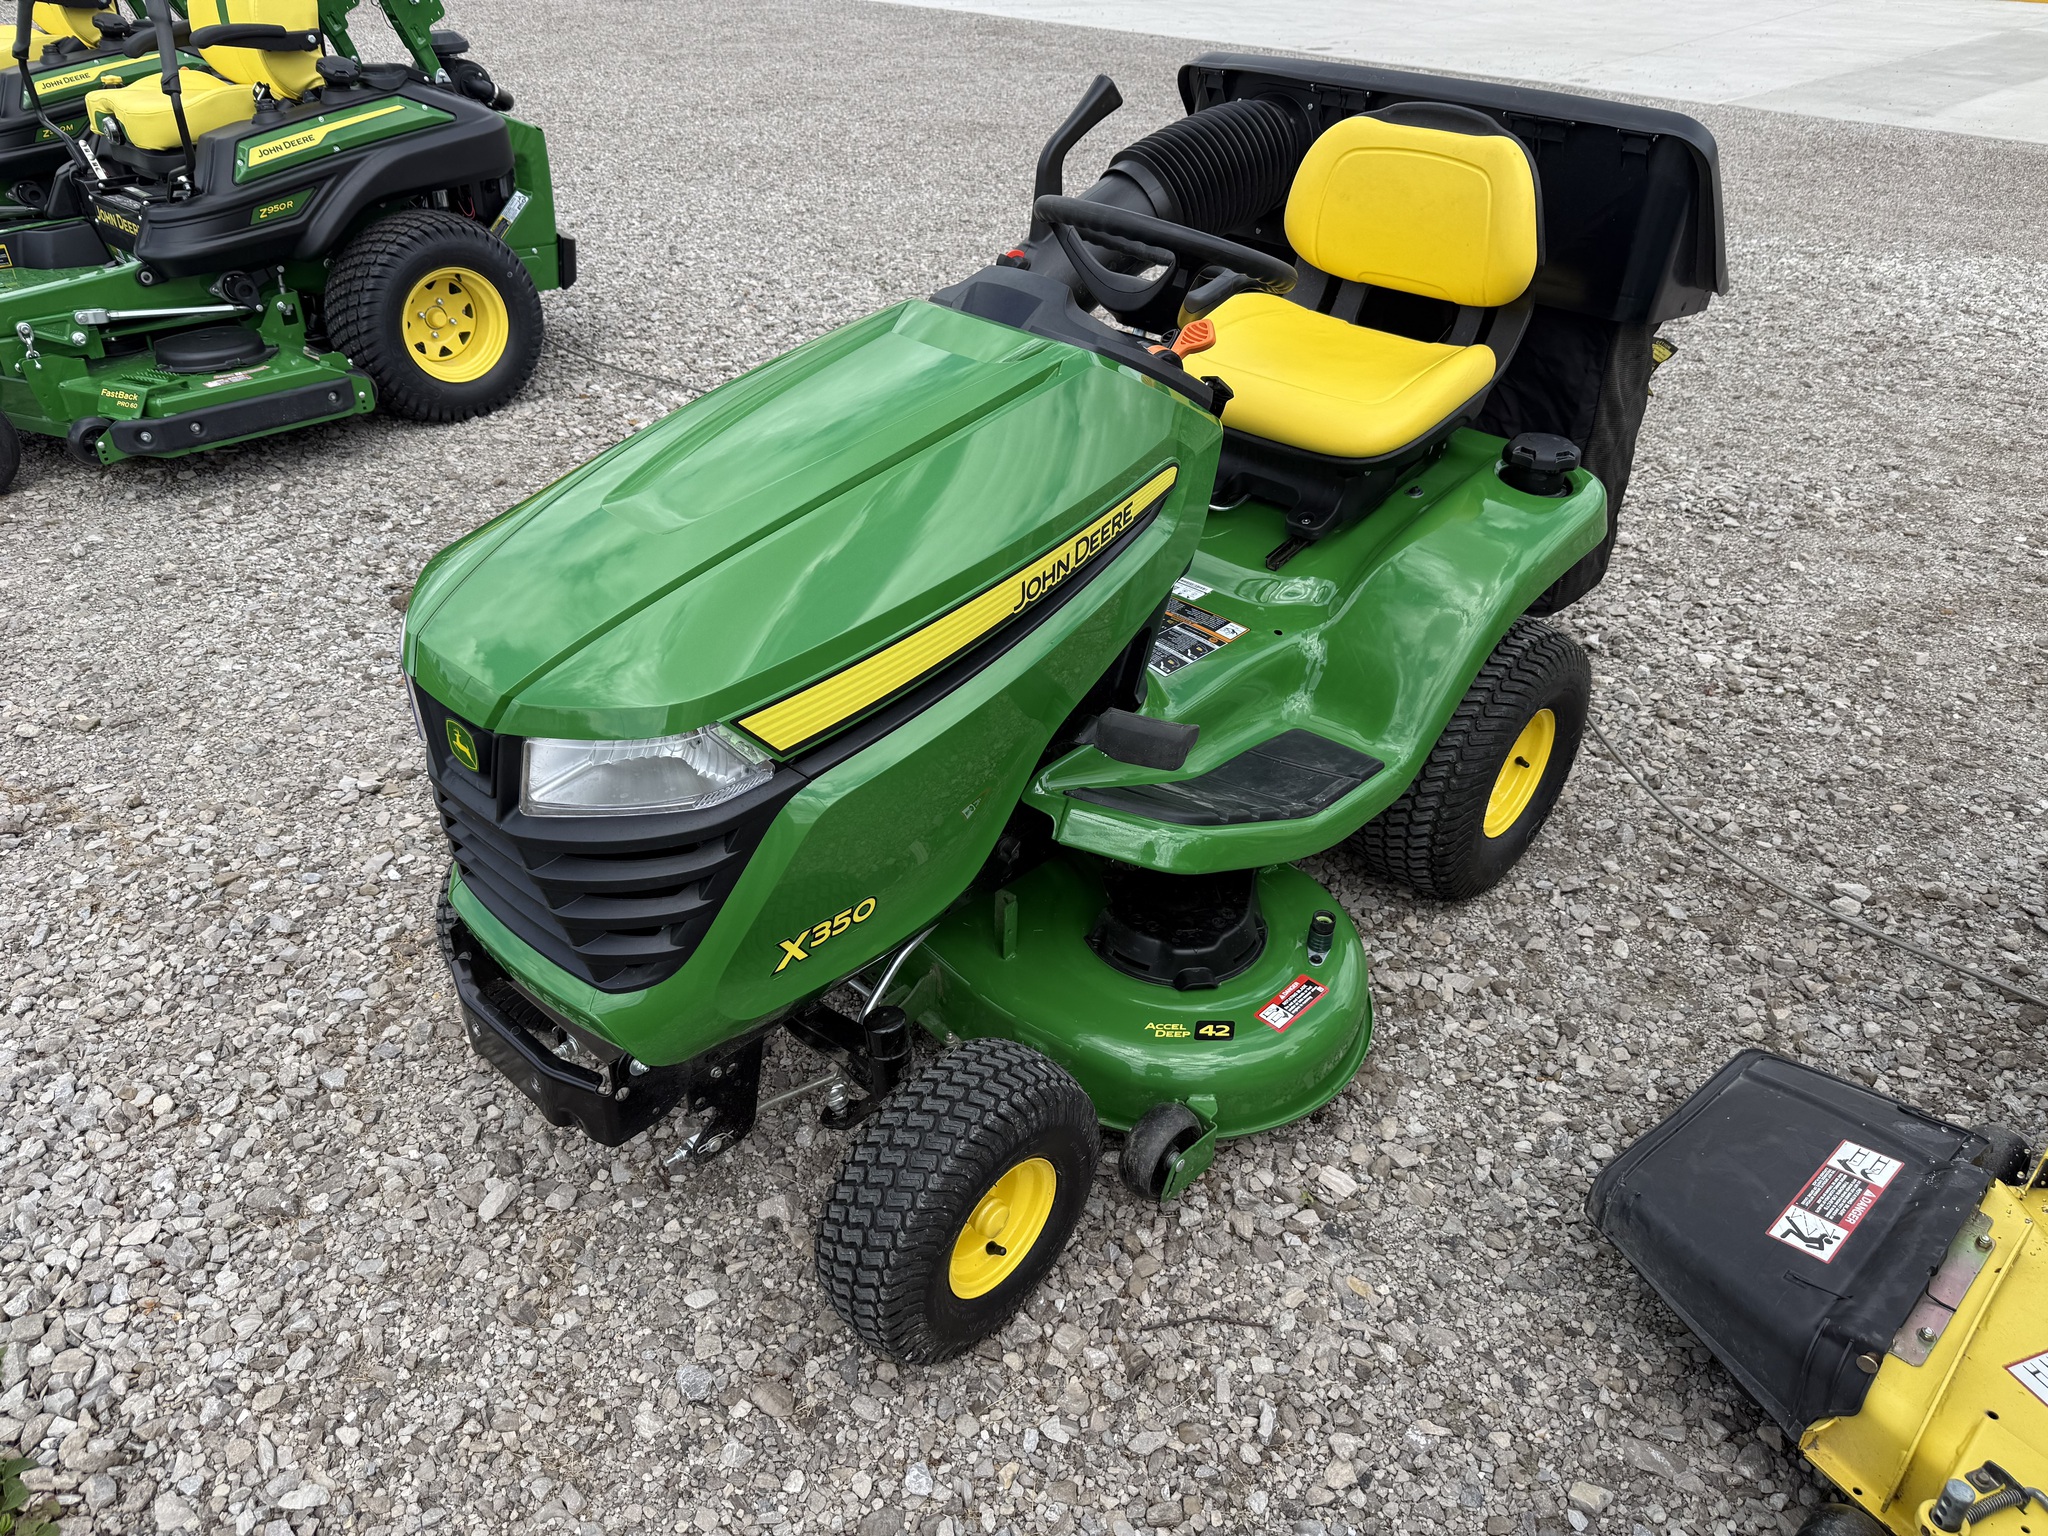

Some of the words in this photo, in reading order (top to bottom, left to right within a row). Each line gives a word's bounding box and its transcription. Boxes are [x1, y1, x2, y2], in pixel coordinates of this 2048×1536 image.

[42, 80, 63, 89] JOHN
[63, 73, 91, 84] DEERE
[43, 124, 74, 137] Z0M
[258, 144, 283, 158] JOHN
[283, 134, 315, 150] DEERE
[259, 200, 293, 219] Z950R
[96, 205, 118, 228] JOHN
[116, 213, 140, 236] DEER
[100, 388, 138, 401] FastBack
[116, 400, 129, 408] PRO
[1013, 552, 1071, 613] JOHN
[1074, 501, 1135, 567] DEERE
[771, 896, 877, 976] X350
[1144, 1022, 1187, 1031] ACCEL
[1154, 1029, 1191, 1038] DEEP
[1198, 1024, 1231, 1037] 42
[1844, 1196, 1873, 1225] DANGER
